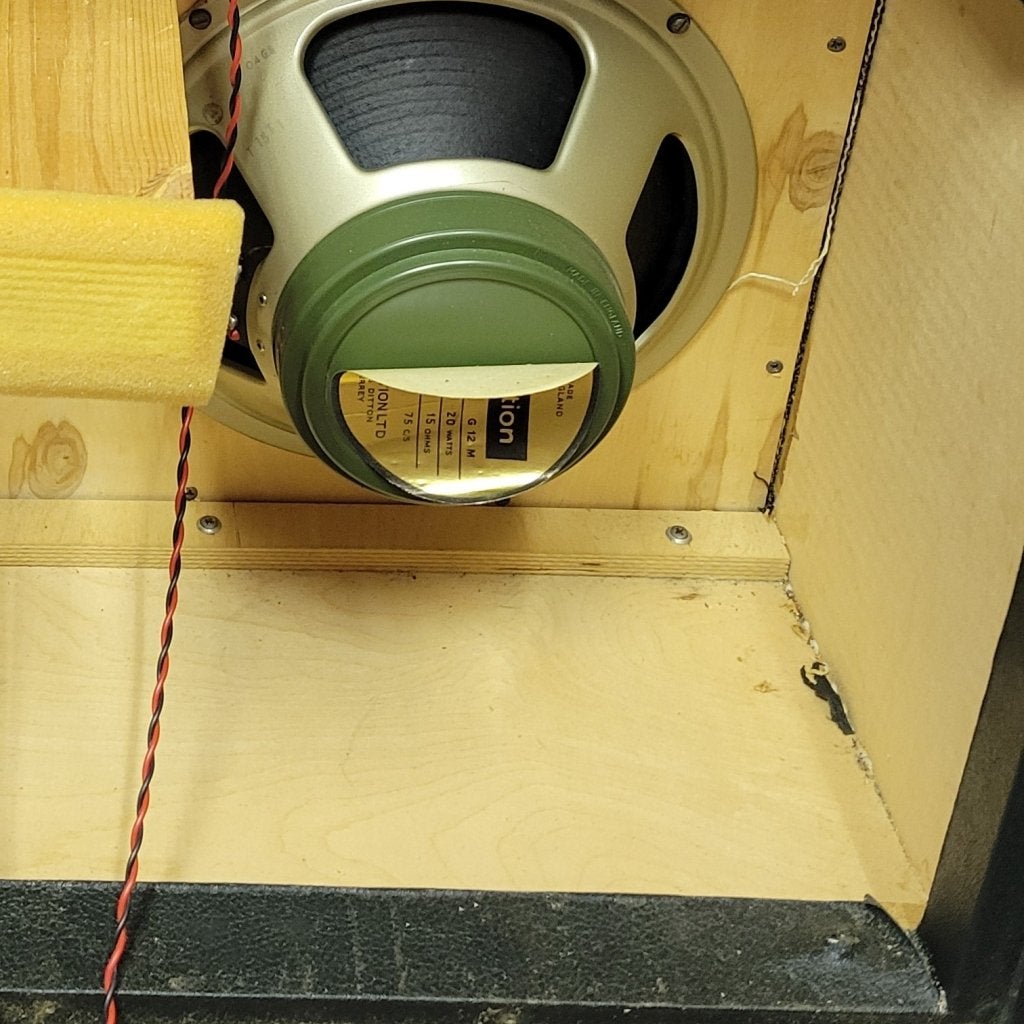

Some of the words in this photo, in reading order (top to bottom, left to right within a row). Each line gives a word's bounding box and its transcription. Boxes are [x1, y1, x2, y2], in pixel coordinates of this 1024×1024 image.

[357, 378, 365, 402] RREY
[556, 386, 566, 417] GLAND
[366, 388, 374, 422] DITTON
[376, 414, 387, 438] LTD
[404, 412, 413, 424] 75
[426, 413, 436, 424] 15
[446, 412, 456, 424] 20
[445, 430, 453, 455] WATTS
[467, 432, 476, 442] 12
